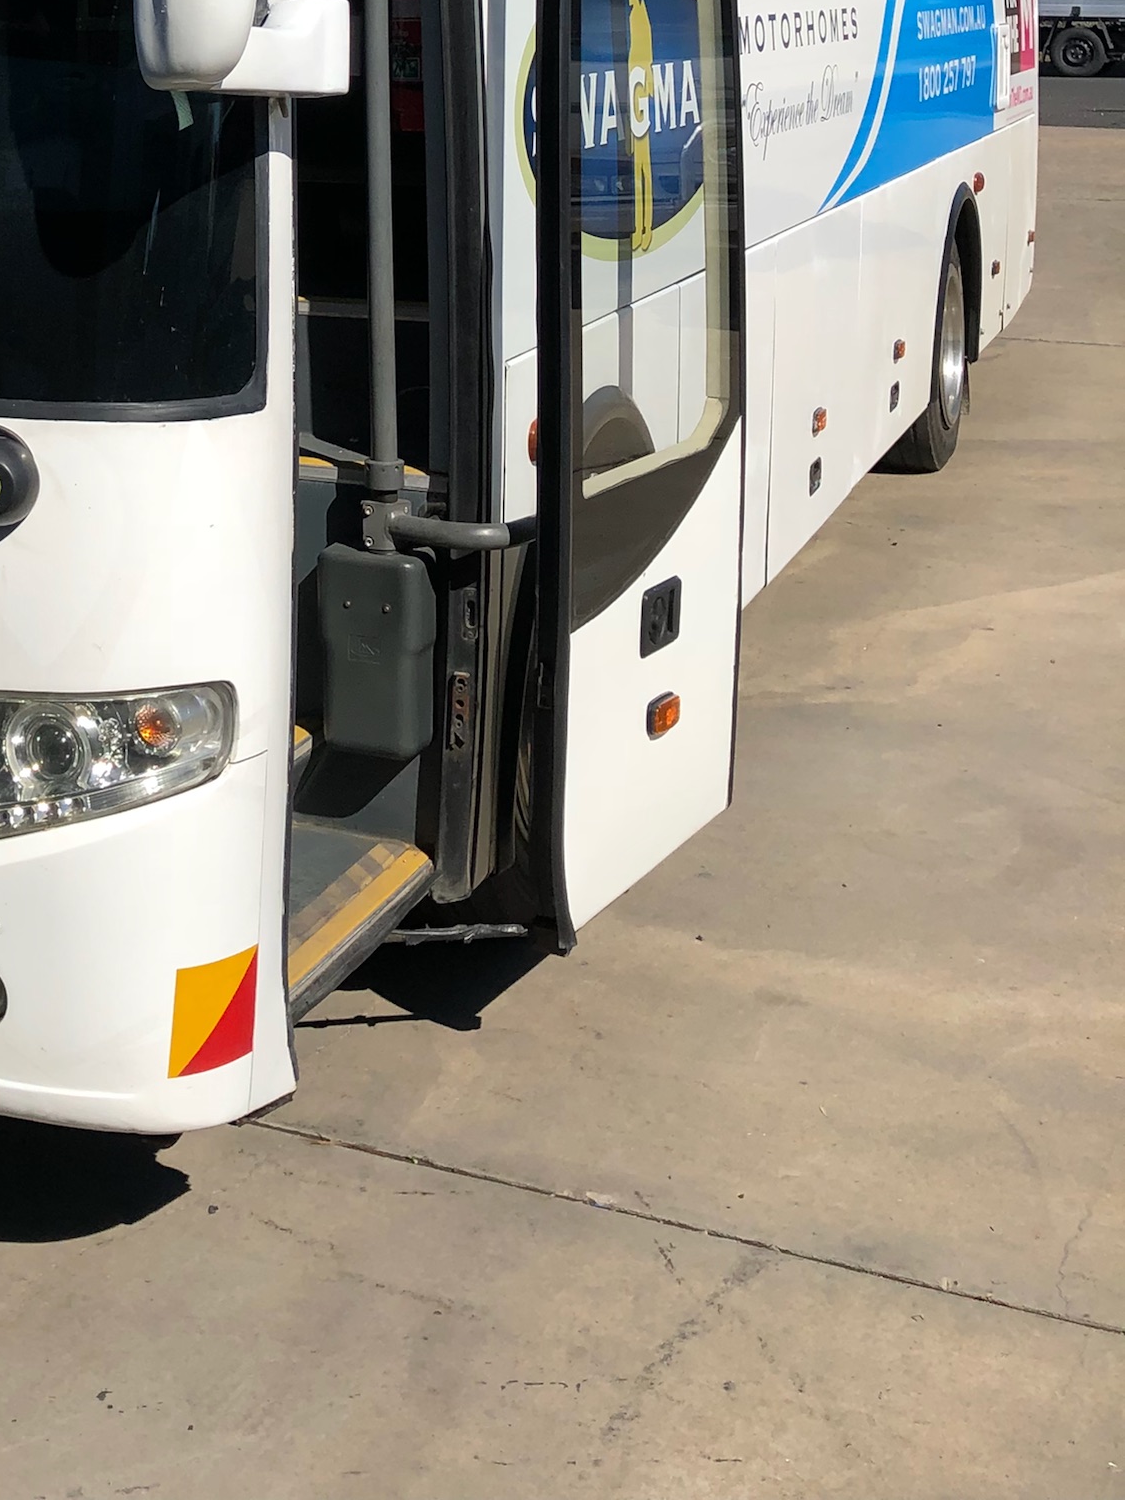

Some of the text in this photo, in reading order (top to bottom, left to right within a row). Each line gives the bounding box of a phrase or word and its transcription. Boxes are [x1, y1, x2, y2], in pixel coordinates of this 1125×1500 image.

[738, 7, 859, 55] MOTORHOMES
[917, 4, 986, 41] SWAGMAN.COM.AU
[918, 54, 977, 103] 1800 257 797
[806, 81, 819, 125] the
